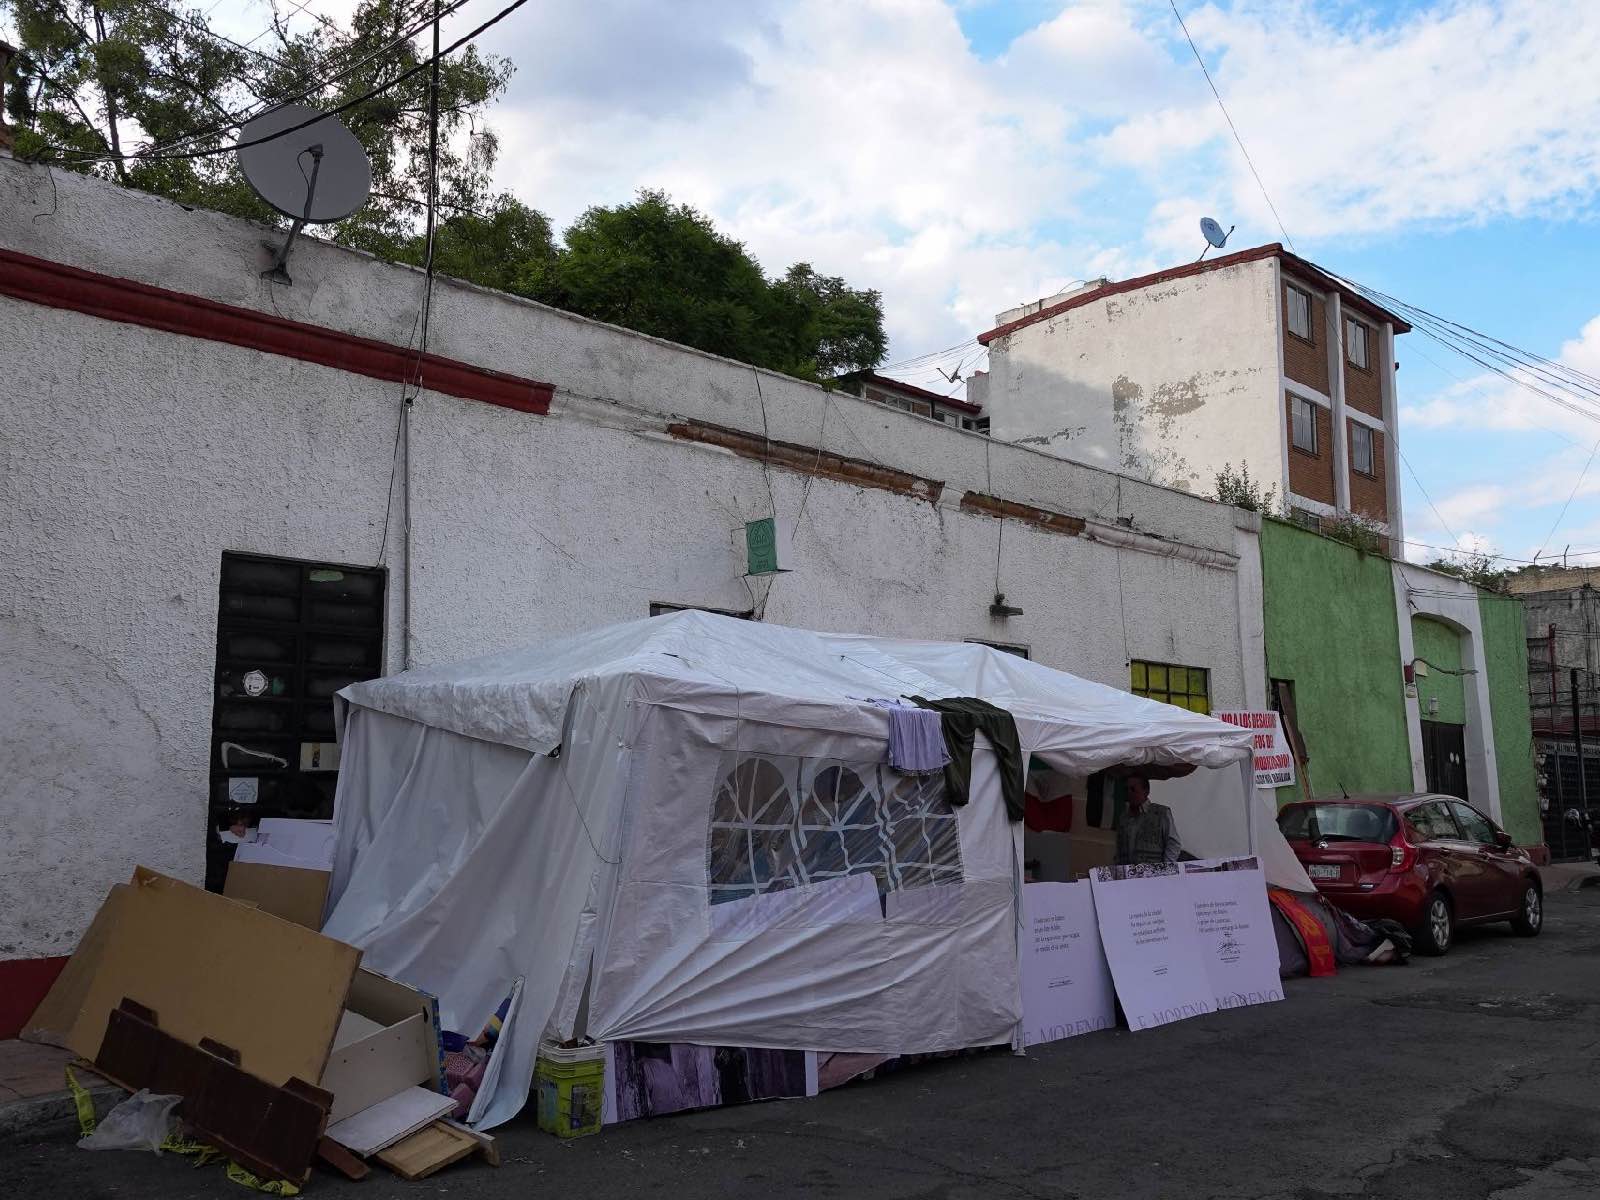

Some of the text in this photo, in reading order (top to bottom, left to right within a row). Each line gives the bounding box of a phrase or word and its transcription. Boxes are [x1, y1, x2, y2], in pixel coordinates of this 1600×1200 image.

[1240, 711, 1251, 729] LOS
[1216, 989, 1280, 1009] MORENO
[1152, 1001, 1209, 1025] MORENO
[1040, 1016, 1106, 1042] MORENO
